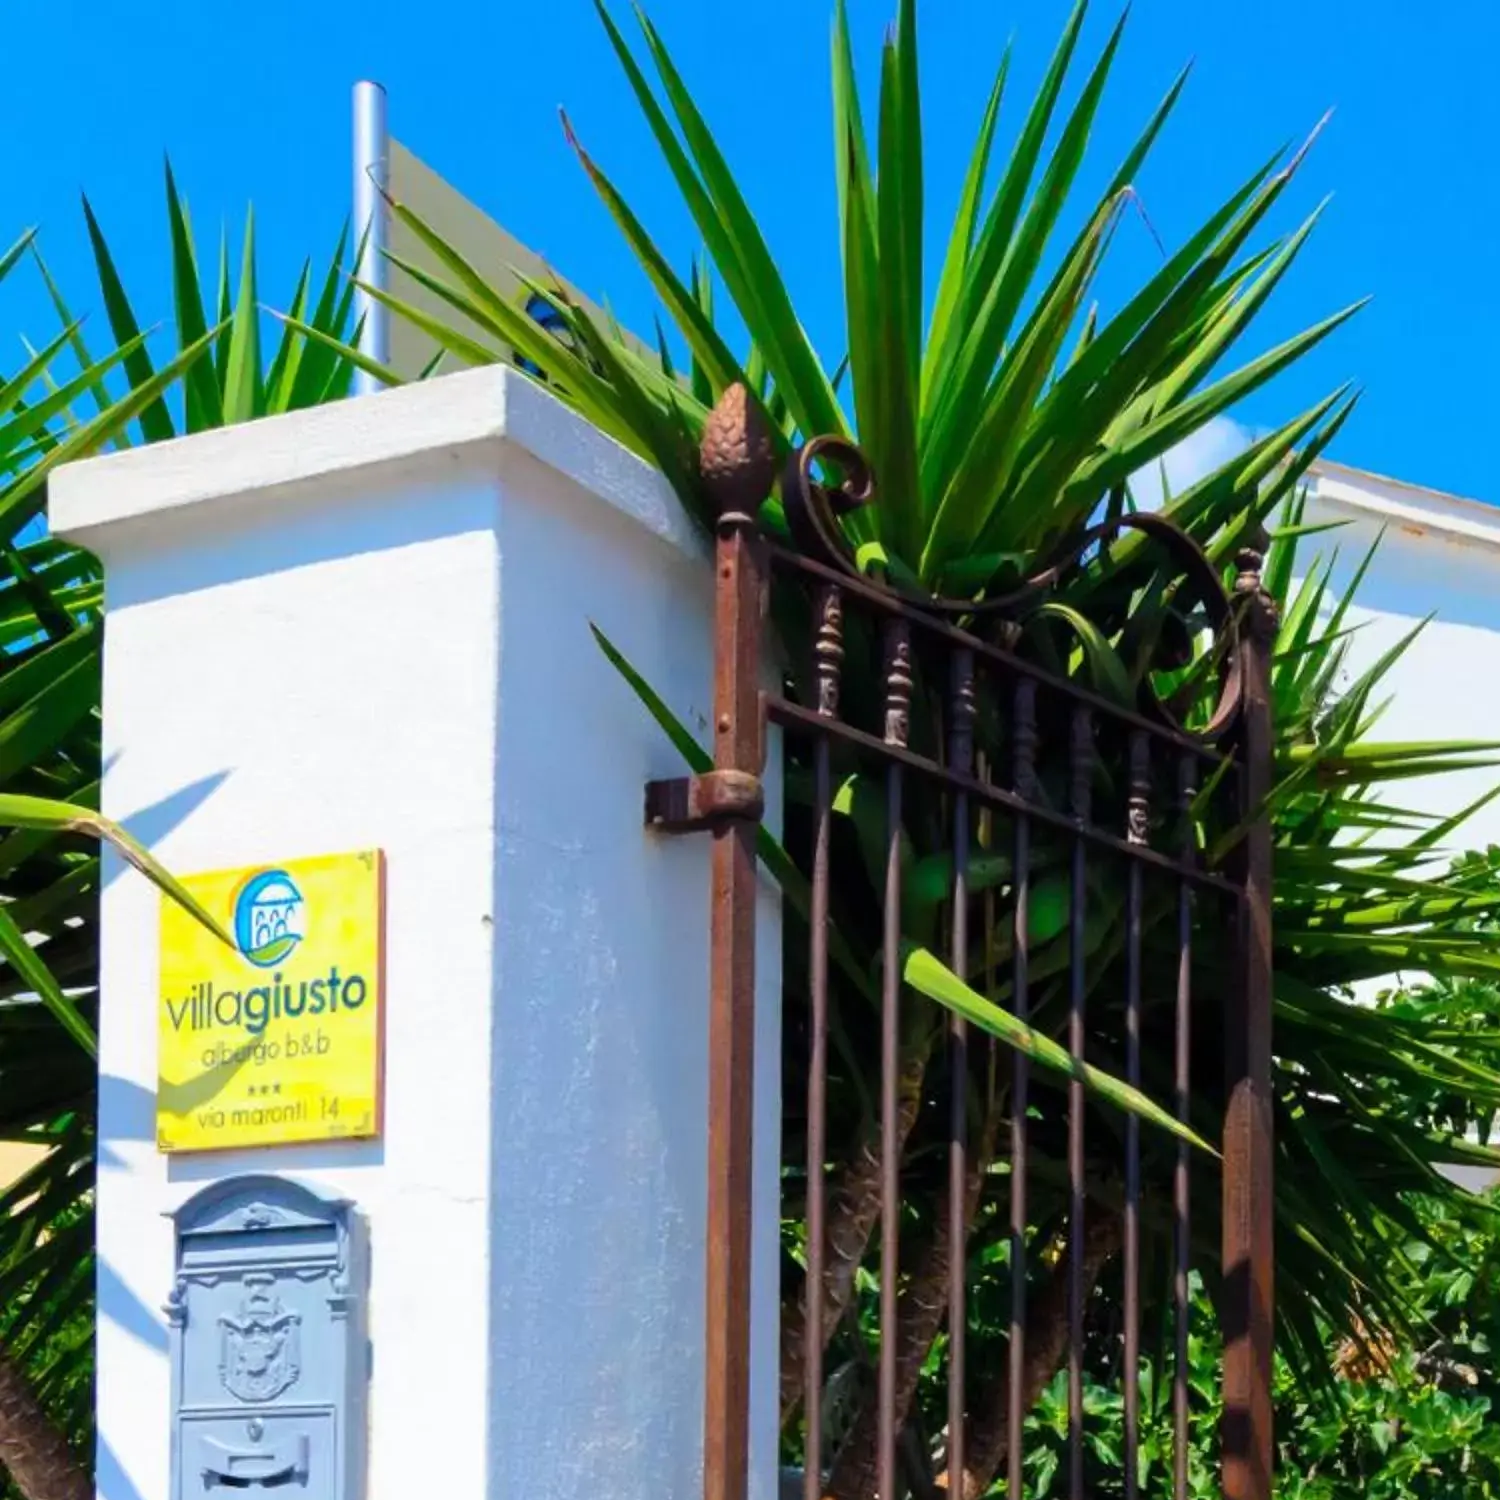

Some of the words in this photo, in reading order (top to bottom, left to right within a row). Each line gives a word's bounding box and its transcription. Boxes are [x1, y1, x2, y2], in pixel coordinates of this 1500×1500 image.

[165, 966, 367, 1034] villagiusto
[285, 1027, 331, 1059] b&b
[197, 1106, 225, 1128] via
[320, 1095, 339, 1120] 14
